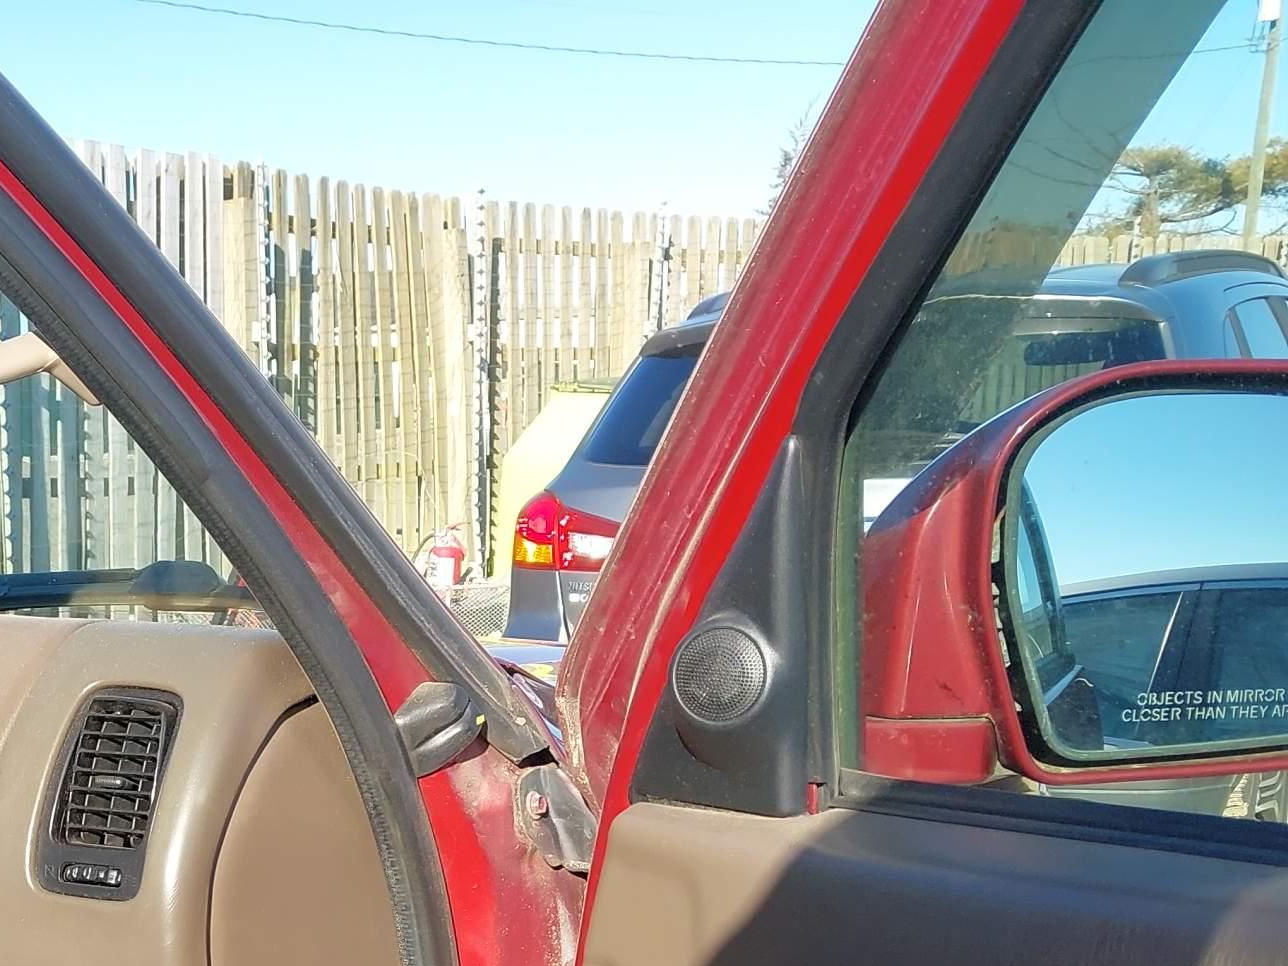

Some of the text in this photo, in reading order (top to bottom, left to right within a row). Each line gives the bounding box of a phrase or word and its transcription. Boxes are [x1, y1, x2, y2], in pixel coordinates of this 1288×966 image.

[1137, 688, 1285, 706] OBJECTS IN MIRROR
[1122, 707, 1182, 722] CLOSER
[1186, 706, 1226, 721] THAN
[1231, 705, 1269, 719] THEY
